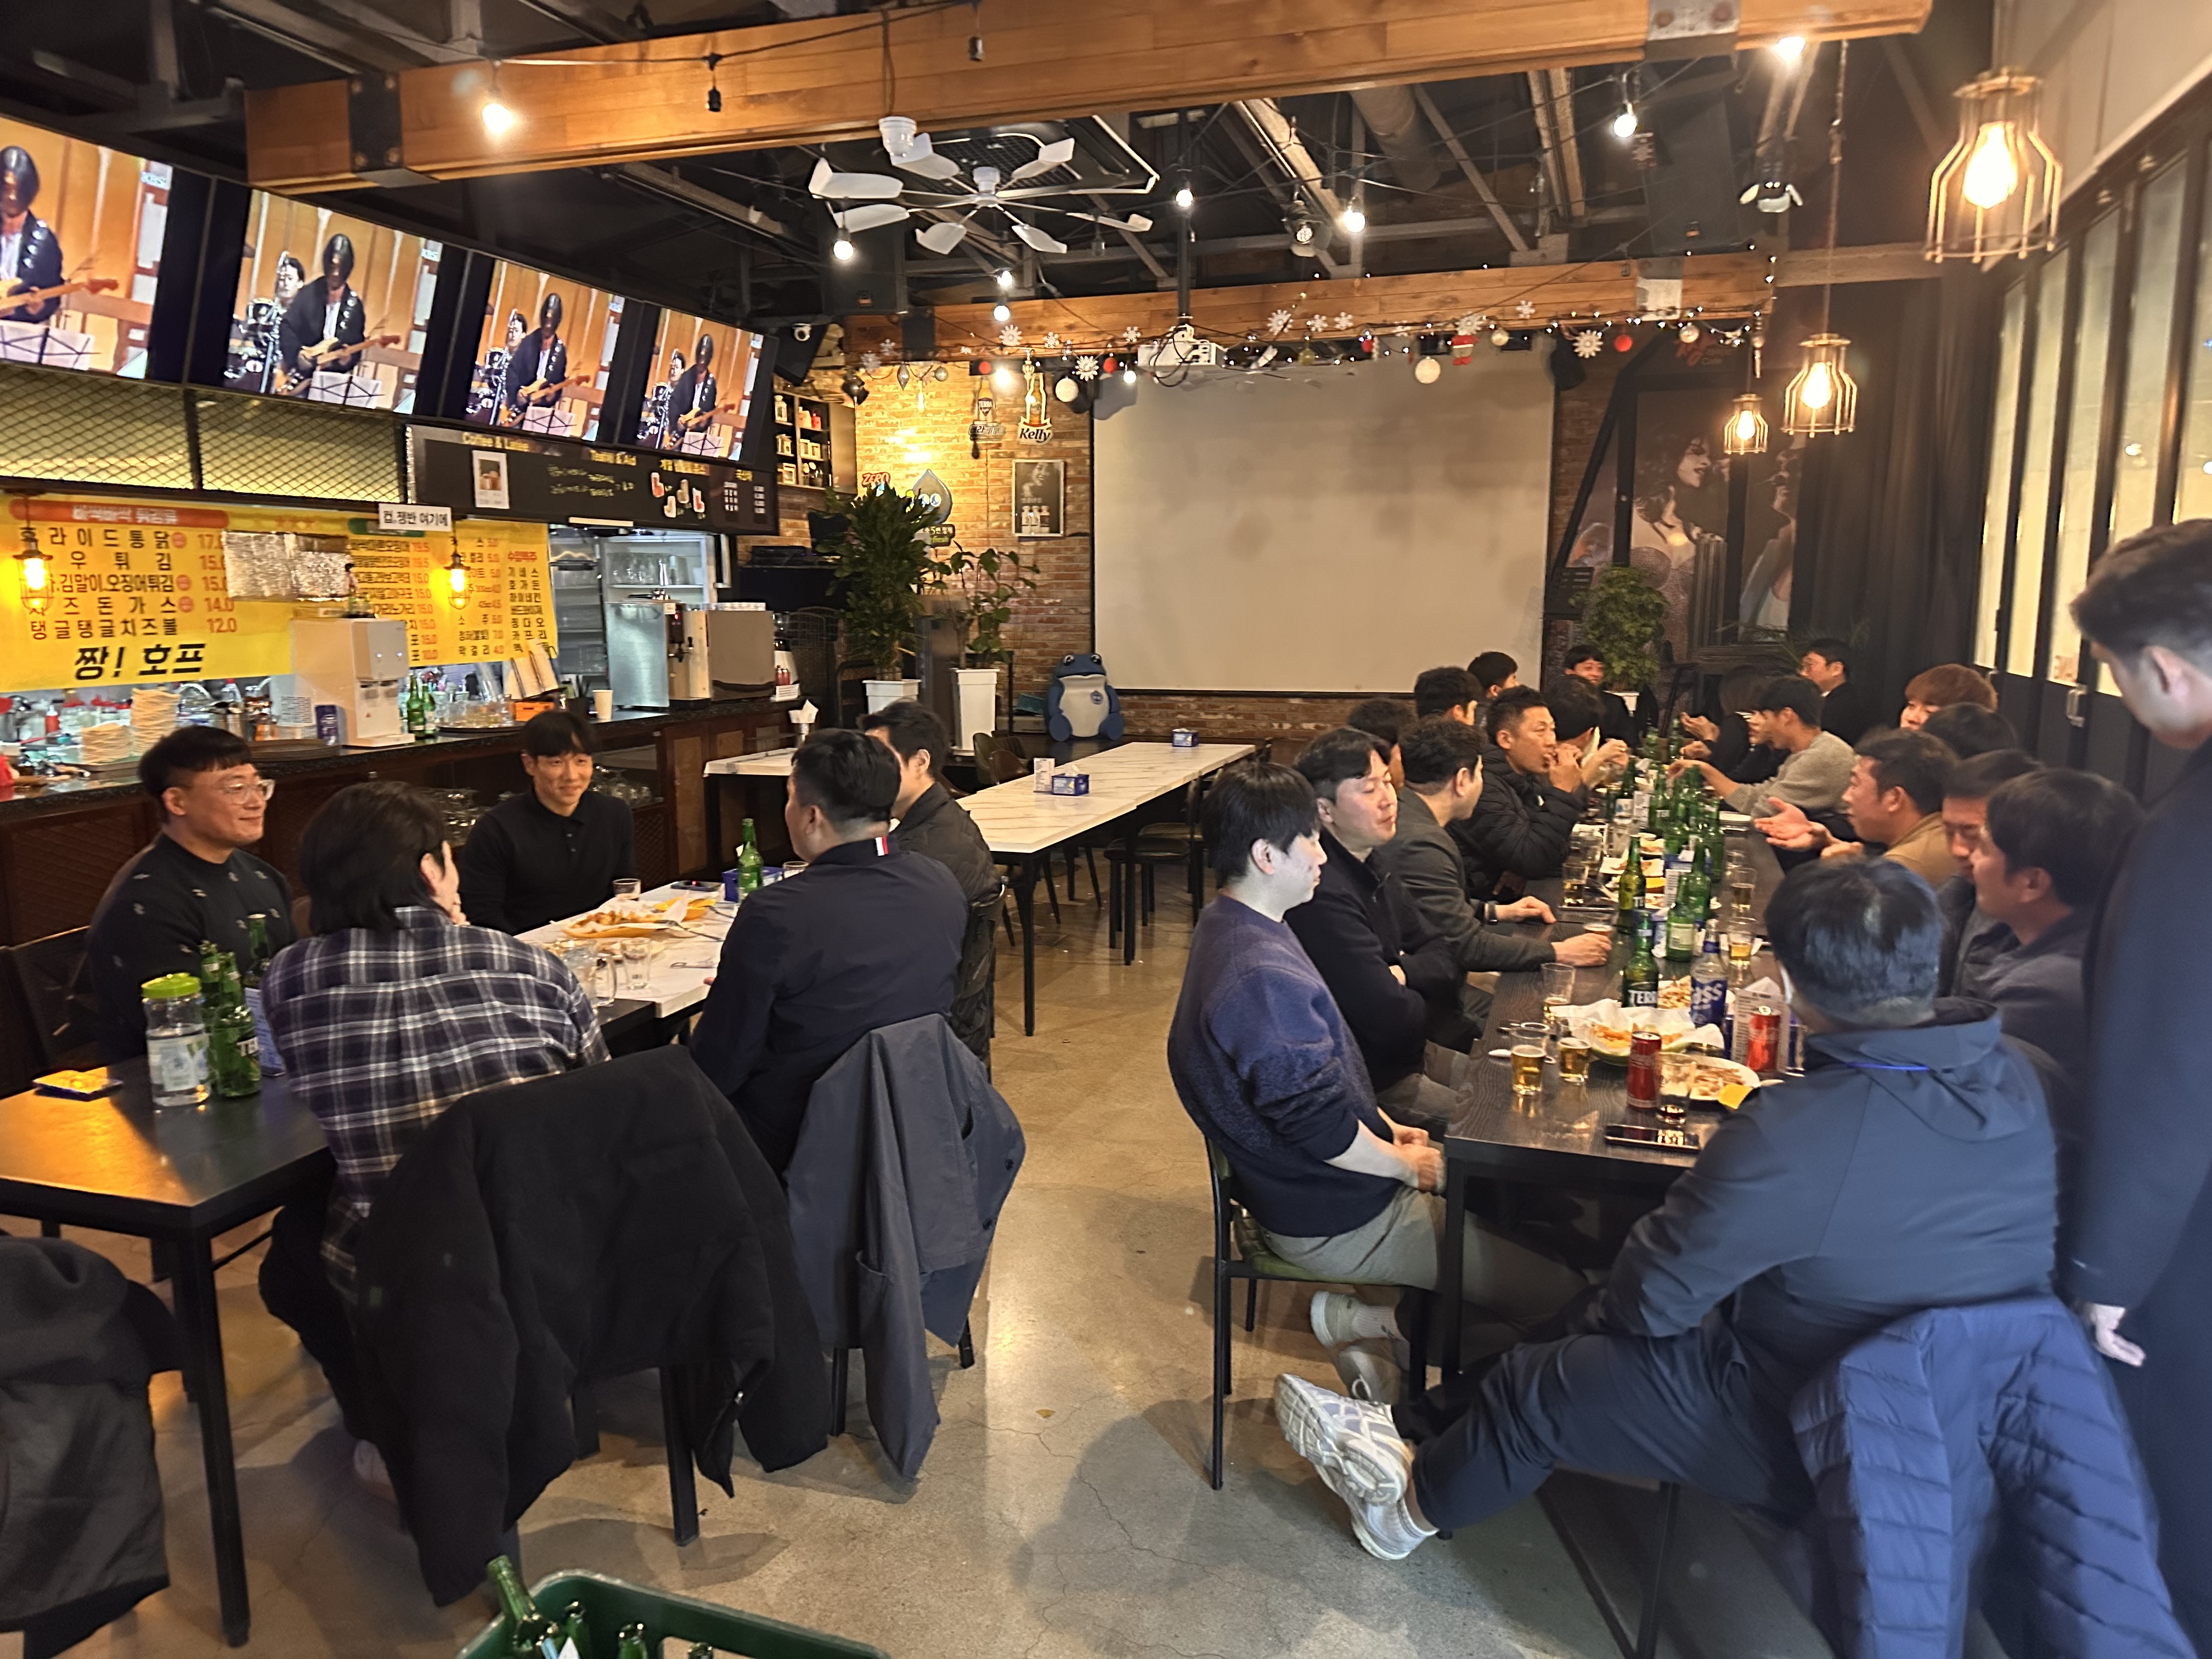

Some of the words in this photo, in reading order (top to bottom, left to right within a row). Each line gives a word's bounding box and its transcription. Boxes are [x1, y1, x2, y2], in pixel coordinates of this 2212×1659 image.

[1019, 428, 1051, 443] Kelly
[862, 472, 889, 486] ZERO
[419, 512, 448, 526] 여기에
[413, 573, 429, 584] 15.0
[508, 566, 539, 577] 기네스
[509, 579, 541, 590] 호가든
[415, 588, 432, 599] 15.0
[205, 597, 235, 612] 14.0
[207, 618, 238, 634] 12.0
[458, 645, 490, 656] 막걸리
[75, 644, 126, 680] 짱!
[138, 643, 206, 676] 호프
